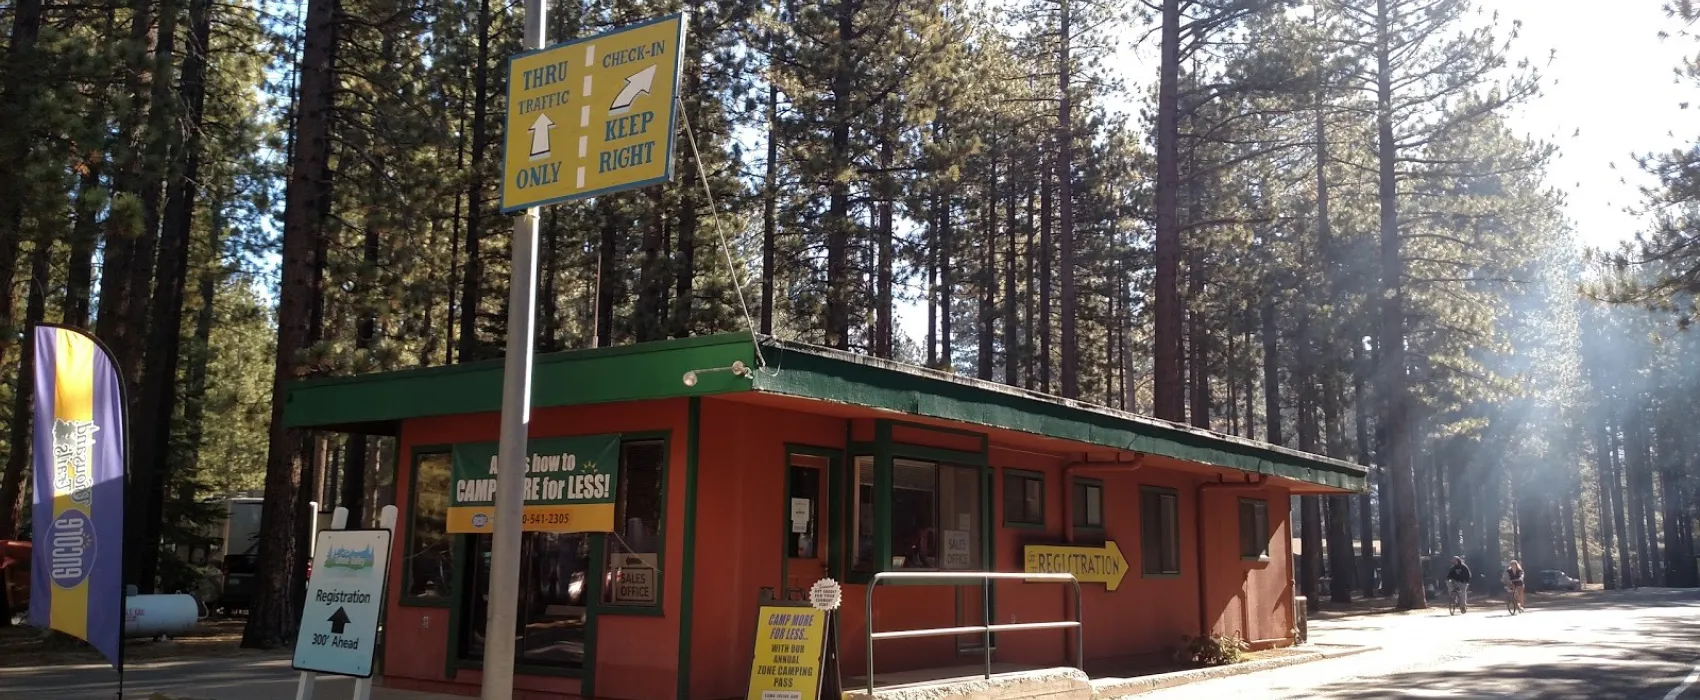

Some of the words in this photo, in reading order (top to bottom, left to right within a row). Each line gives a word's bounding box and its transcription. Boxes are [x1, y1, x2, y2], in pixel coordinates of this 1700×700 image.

[602, 40, 665, 68] CHECK-IN
[523, 61, 568, 91] THRU
[518, 90, 570, 115] TRAFFIC
[604, 111, 654, 142] KEEP
[599, 141, 655, 174] RIGHT
[516, 161, 562, 190] ONLY
[532, 453, 561, 473] how
[562, 453, 576, 471] to
[542, 478, 565, 500] for
[567, 473, 611, 499] LESS!
[1038, 552, 1119, 575] REGISTRATION
[621, 572, 646, 584] SALES
[315, 588, 371, 606] Registration
[620, 586, 649, 597] OFFICE
[768, 614, 791, 627] CAMP
[791, 615, 814, 627] MORE
[331, 635, 359, 650] Ahead
[769, 628, 785, 640] FOR
[771, 644, 790, 653] WITH
[790, 645, 805, 654] OUR
[773, 655, 799, 664] ANNUAL
[757, 665, 776, 675] ZONE
[778, 666, 813, 677] CAMPING
[773, 678, 793, 688] PASS
